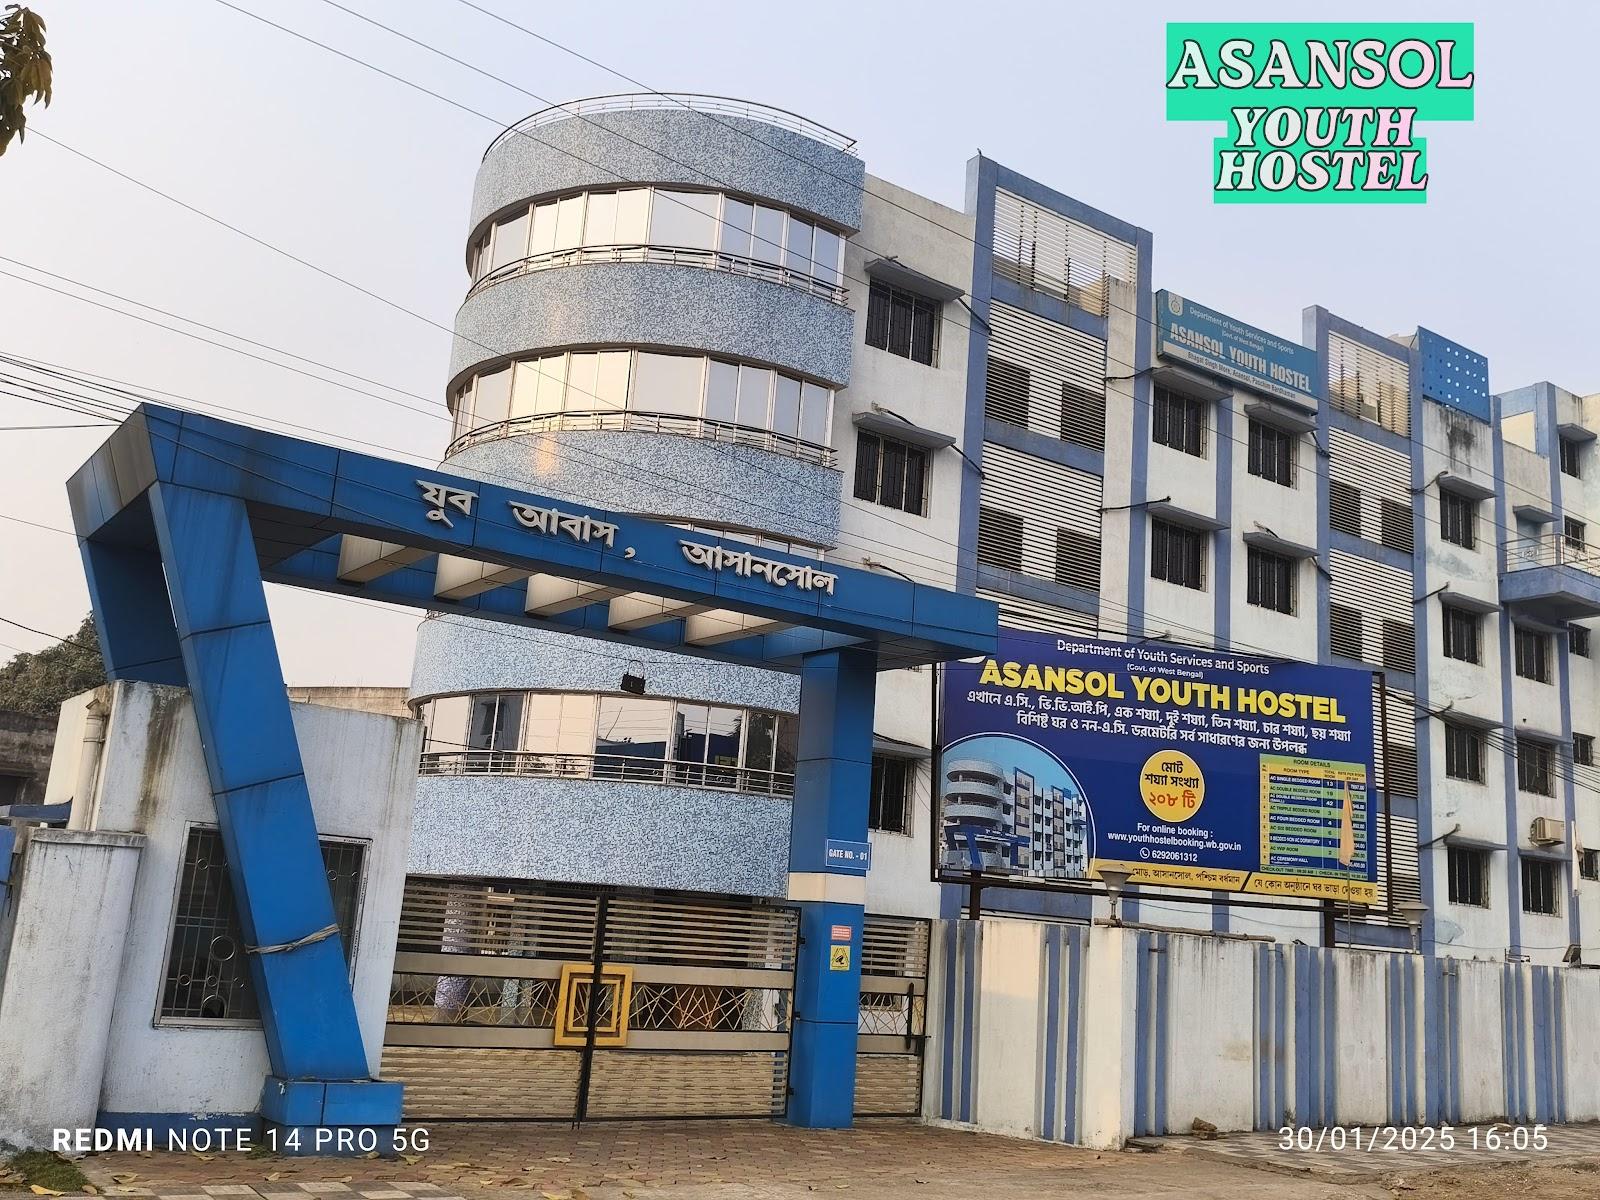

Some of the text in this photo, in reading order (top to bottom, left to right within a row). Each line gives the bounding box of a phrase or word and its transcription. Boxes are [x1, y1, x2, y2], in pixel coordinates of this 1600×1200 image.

[1189, 306, 1222, 328] Department
[1229, 321, 1245, 335] Youth
[1245, 329, 1266, 344] Services
[1266, 334, 1277, 346] and
[1277, 340, 1295, 355] Sports
[1170, 322, 1312, 393] ASANSOL YOUTH HOSTEL
[415, 478, 479, 529] যুব
[679, 538, 840, 597] আসানসোল
[1057, 640, 1270, 675] Department of Youth Services and Sports
[1149, 665, 1156, 673] of
[1158, 666, 1175, 675] West
[1176, 669, 1204, 680] Bengal)
[979, 659, 1346, 723] ASANSOL YOUTH HOSTEL
[967, 690, 1001, 705] এখানে
[1114, 706, 1133, 718] এক
[1166, 709, 1179, 729] দুই
[1211, 714, 1231, 730] তিন
[1263, 722, 1280, 736] চার
[1016, 711, 1049, 728] বিশিষ্ট
[1051, 716, 1067, 730] ঘর
[1070, 719, 1079, 730] ও
[1180, 729, 1196, 743] সর্ব
[1198, 731, 1245, 748] সাধারণের
[1248, 737, 1270, 751] জন্য
[1161, 761, 1184, 774] মোট
[1170, 776, 1200, 789] সংখ্যা
[1149, 789, 1197, 809] ২০৮ টি
[1137, 822, 1150, 833] For
[1152, 824, 1176, 835] online
[1178, 826, 1209, 840] booking
[1107, 832, 1242, 851] www.youthhostelbooking.wb.gov.in
[828, 848, 844, 859] GATE
[844, 850, 855, 860] NO.
[860, 852, 868, 861] 01
[1151, 850, 1198, 862] 6292061312
[1254, 879, 1262, 888] যে
[1265, 880, 1281, 888] কোন
[1313, 884, 1322, 892] ঘর
